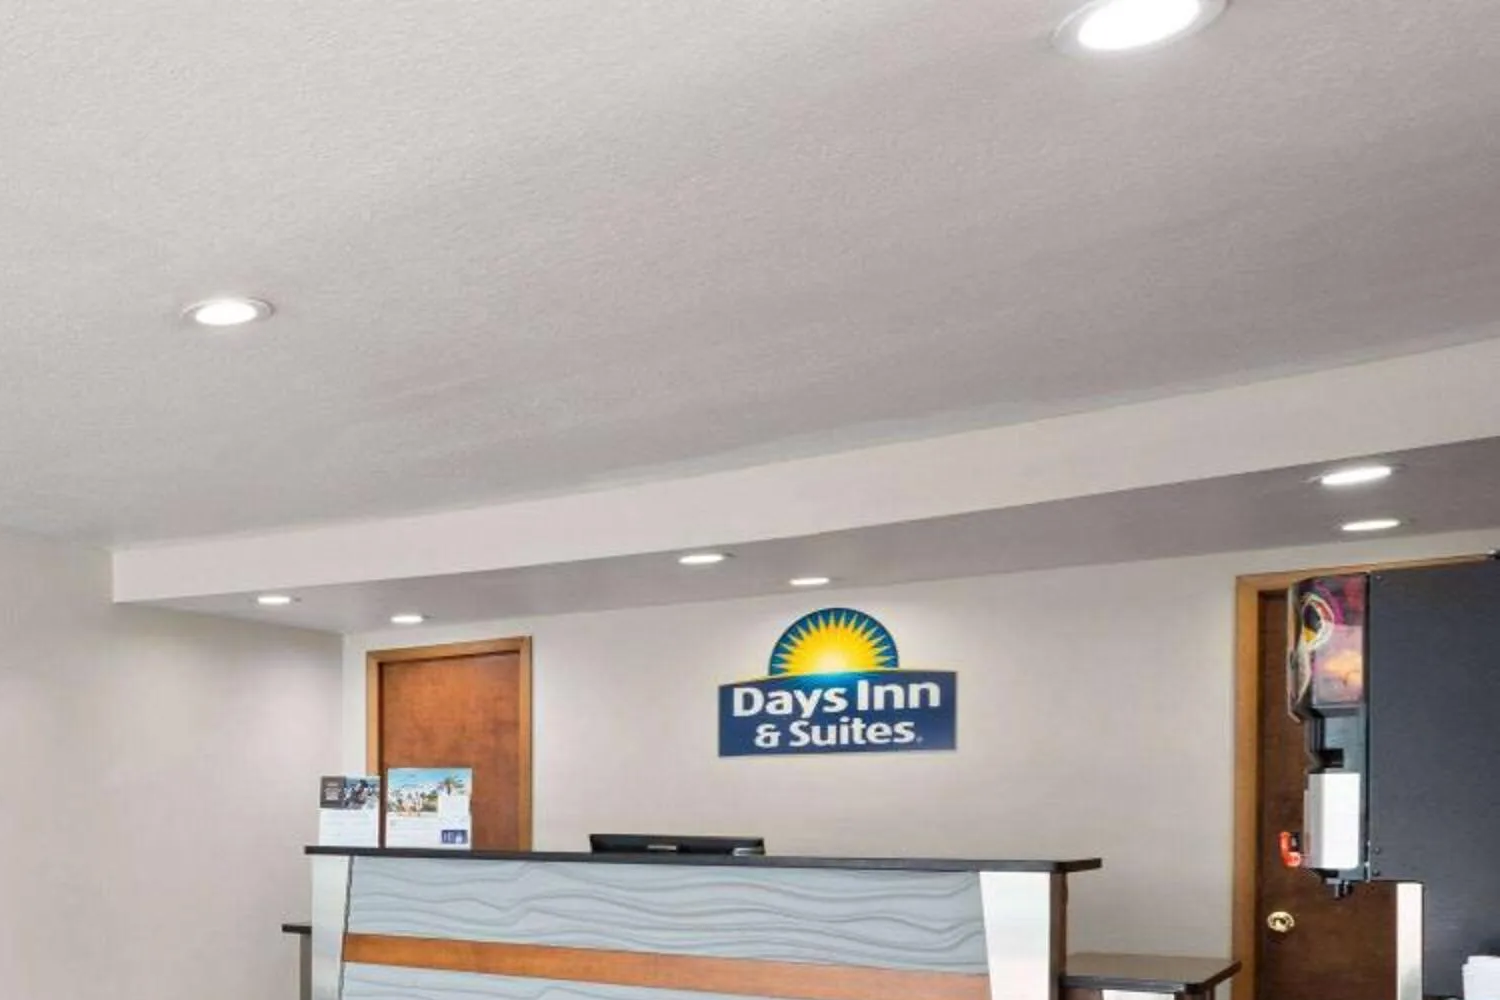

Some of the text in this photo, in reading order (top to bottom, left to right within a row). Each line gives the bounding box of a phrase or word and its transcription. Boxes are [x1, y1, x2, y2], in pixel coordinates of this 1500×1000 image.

[733, 680, 941, 718] Days Inn
[754, 717, 915, 748] & Suites
